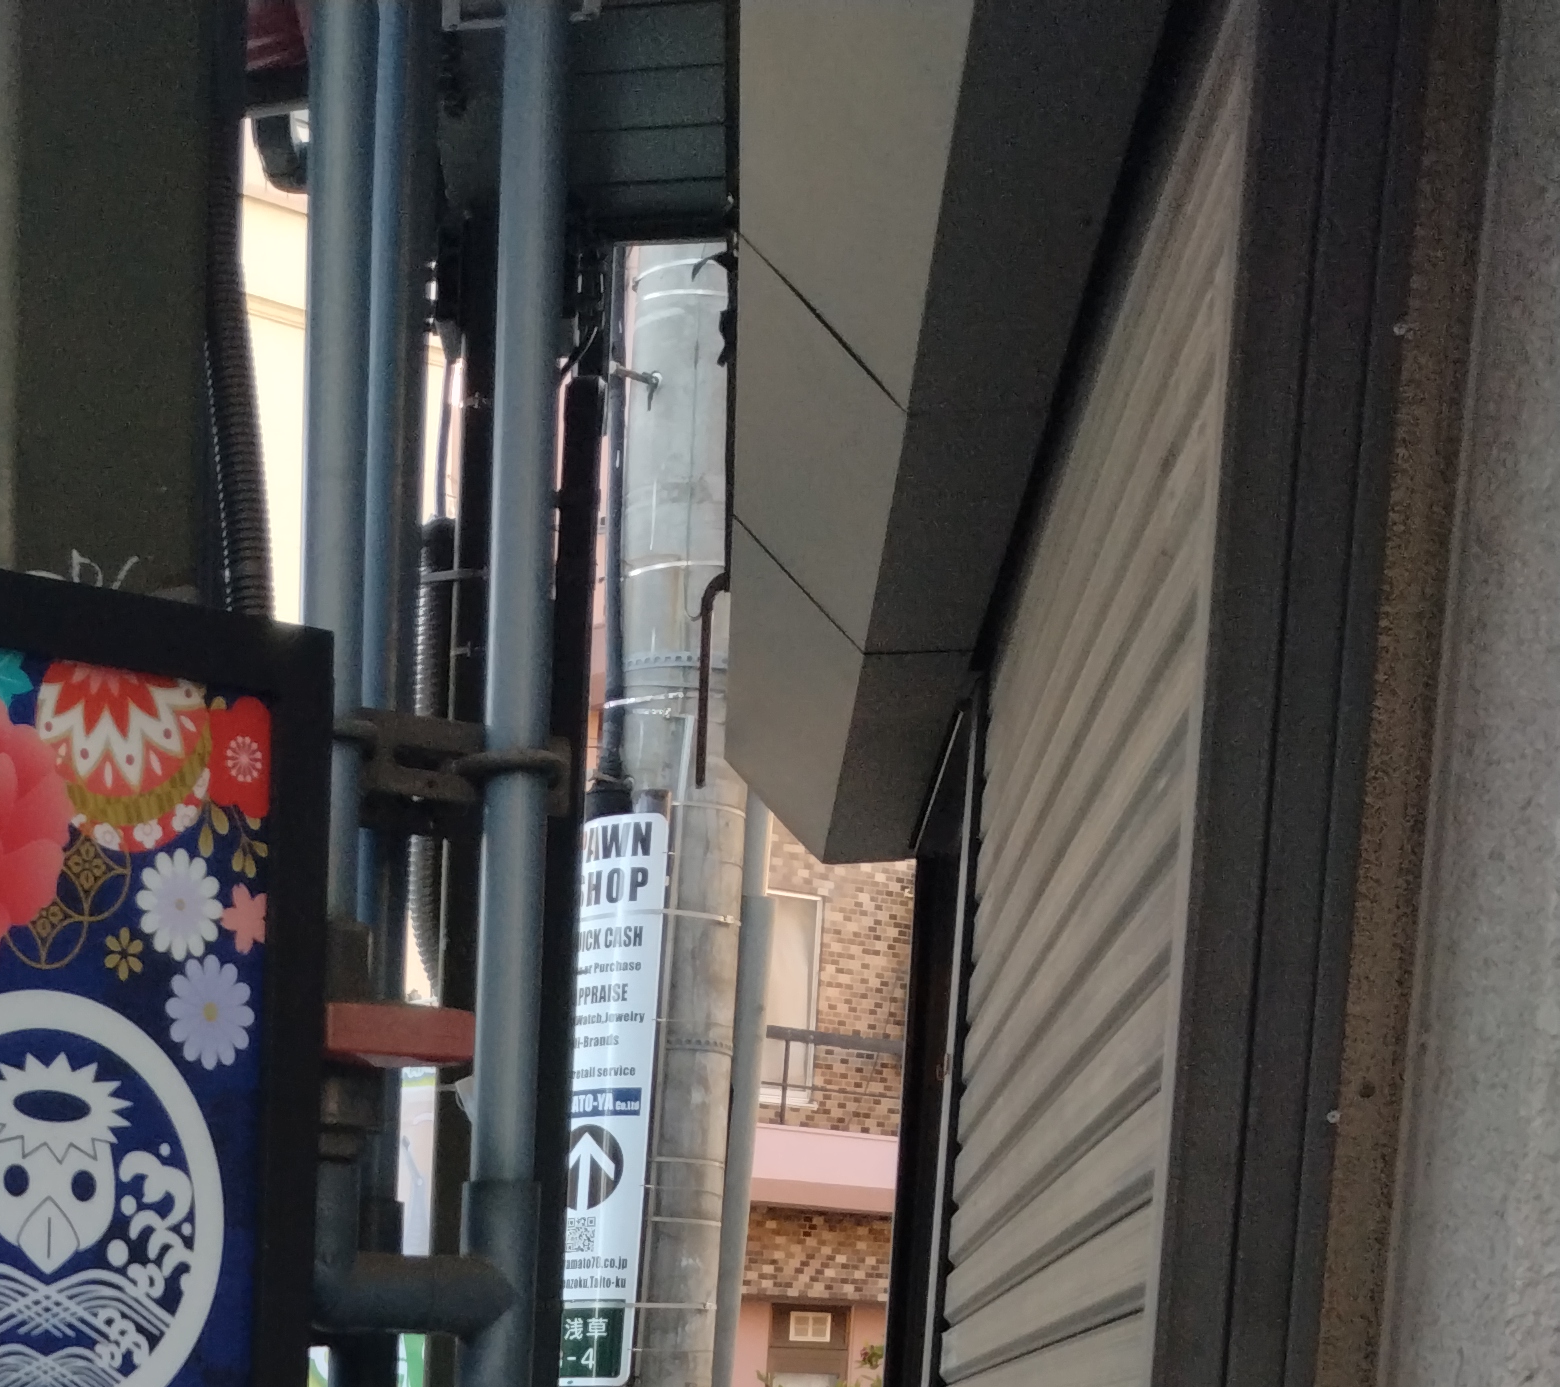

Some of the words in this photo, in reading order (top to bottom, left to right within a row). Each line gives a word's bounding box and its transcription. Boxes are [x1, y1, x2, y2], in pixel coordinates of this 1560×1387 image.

[583, 821, 652, 863] AWN
[604, 925, 644, 948] CASH
[593, 960, 642, 976] Purchase
[577, 983, 628, 1006] PPRAISE
[597, 1065, 636, 1078] service
[571, 1091, 614, 1113] ATO-YA
[564, 1255, 629, 1271] amato78.co.jp
[564, 1317, 609, 1340] 浅草
[559, 1347, 595, 1371] -4
